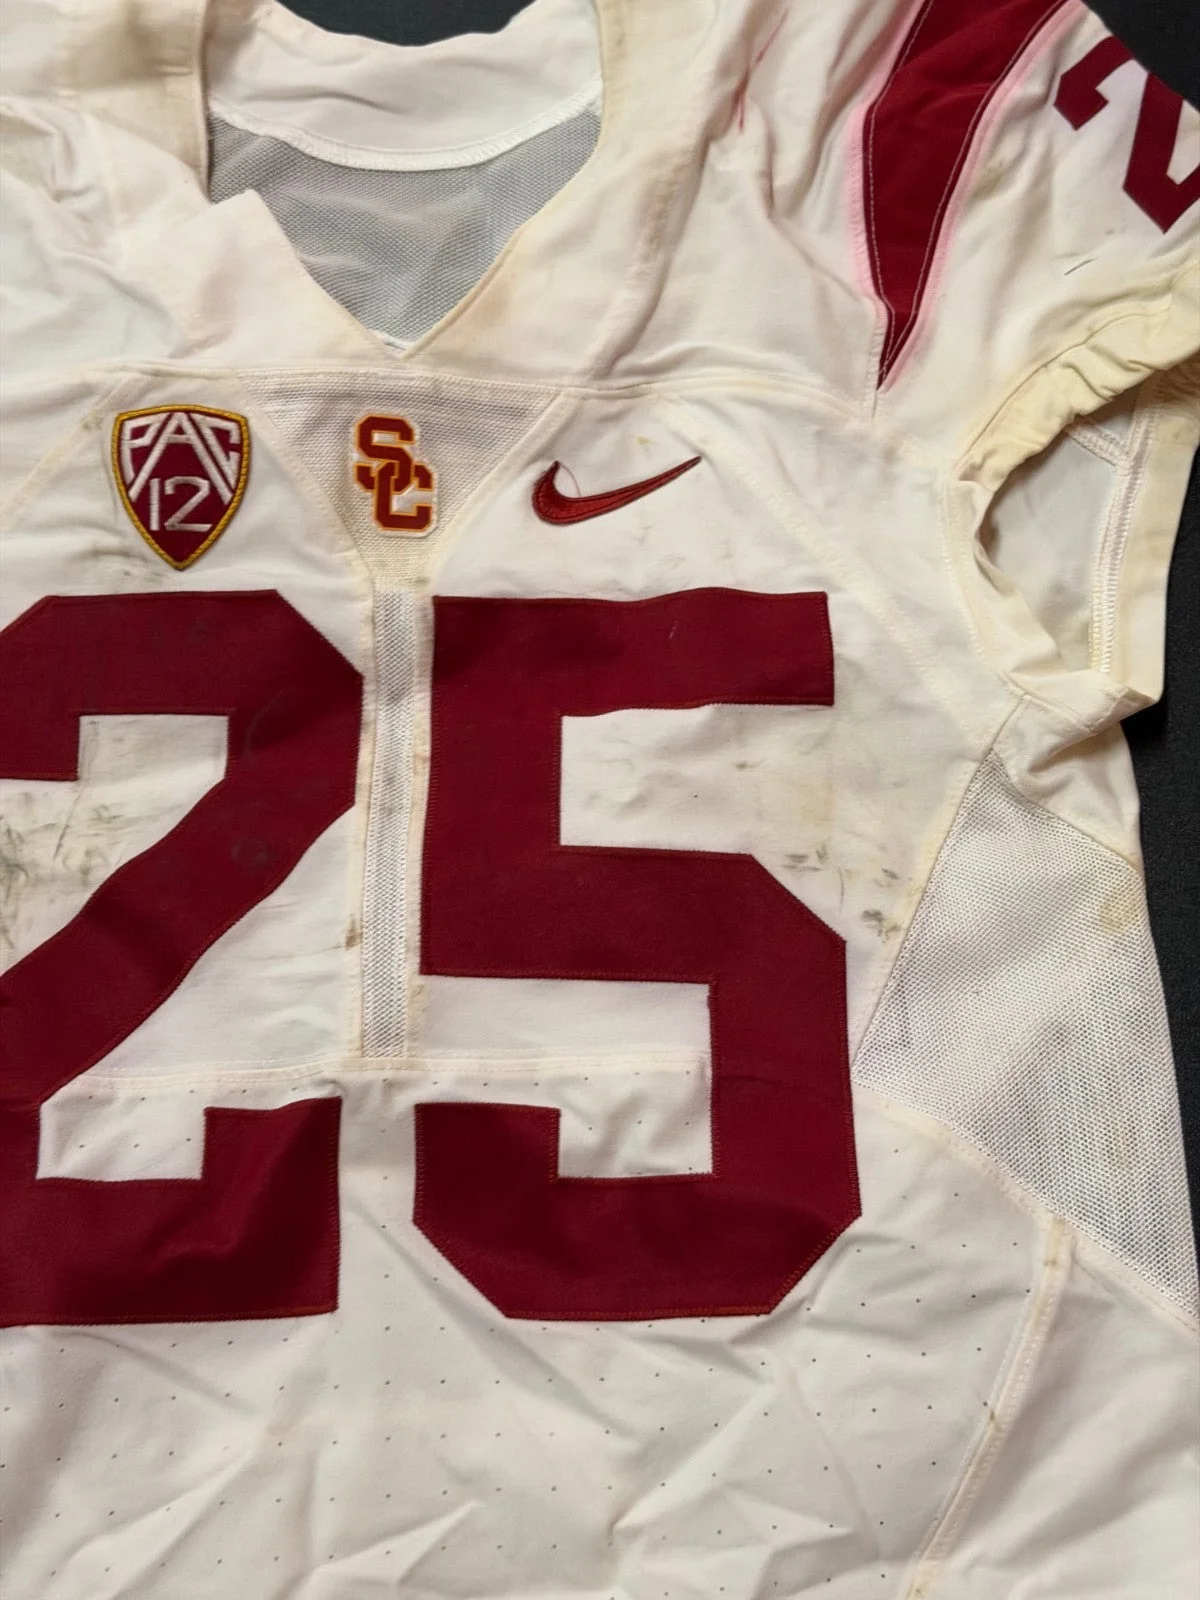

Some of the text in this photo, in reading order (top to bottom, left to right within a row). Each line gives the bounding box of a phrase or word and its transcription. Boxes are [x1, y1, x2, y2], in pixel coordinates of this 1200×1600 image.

[1053, 35, 1200, 234] 2
[120, 412, 242, 505] PAC
[150, 476, 212, 532] 12
[353, 413, 433, 532] SC
[0, 587, 862, 1327] 25
